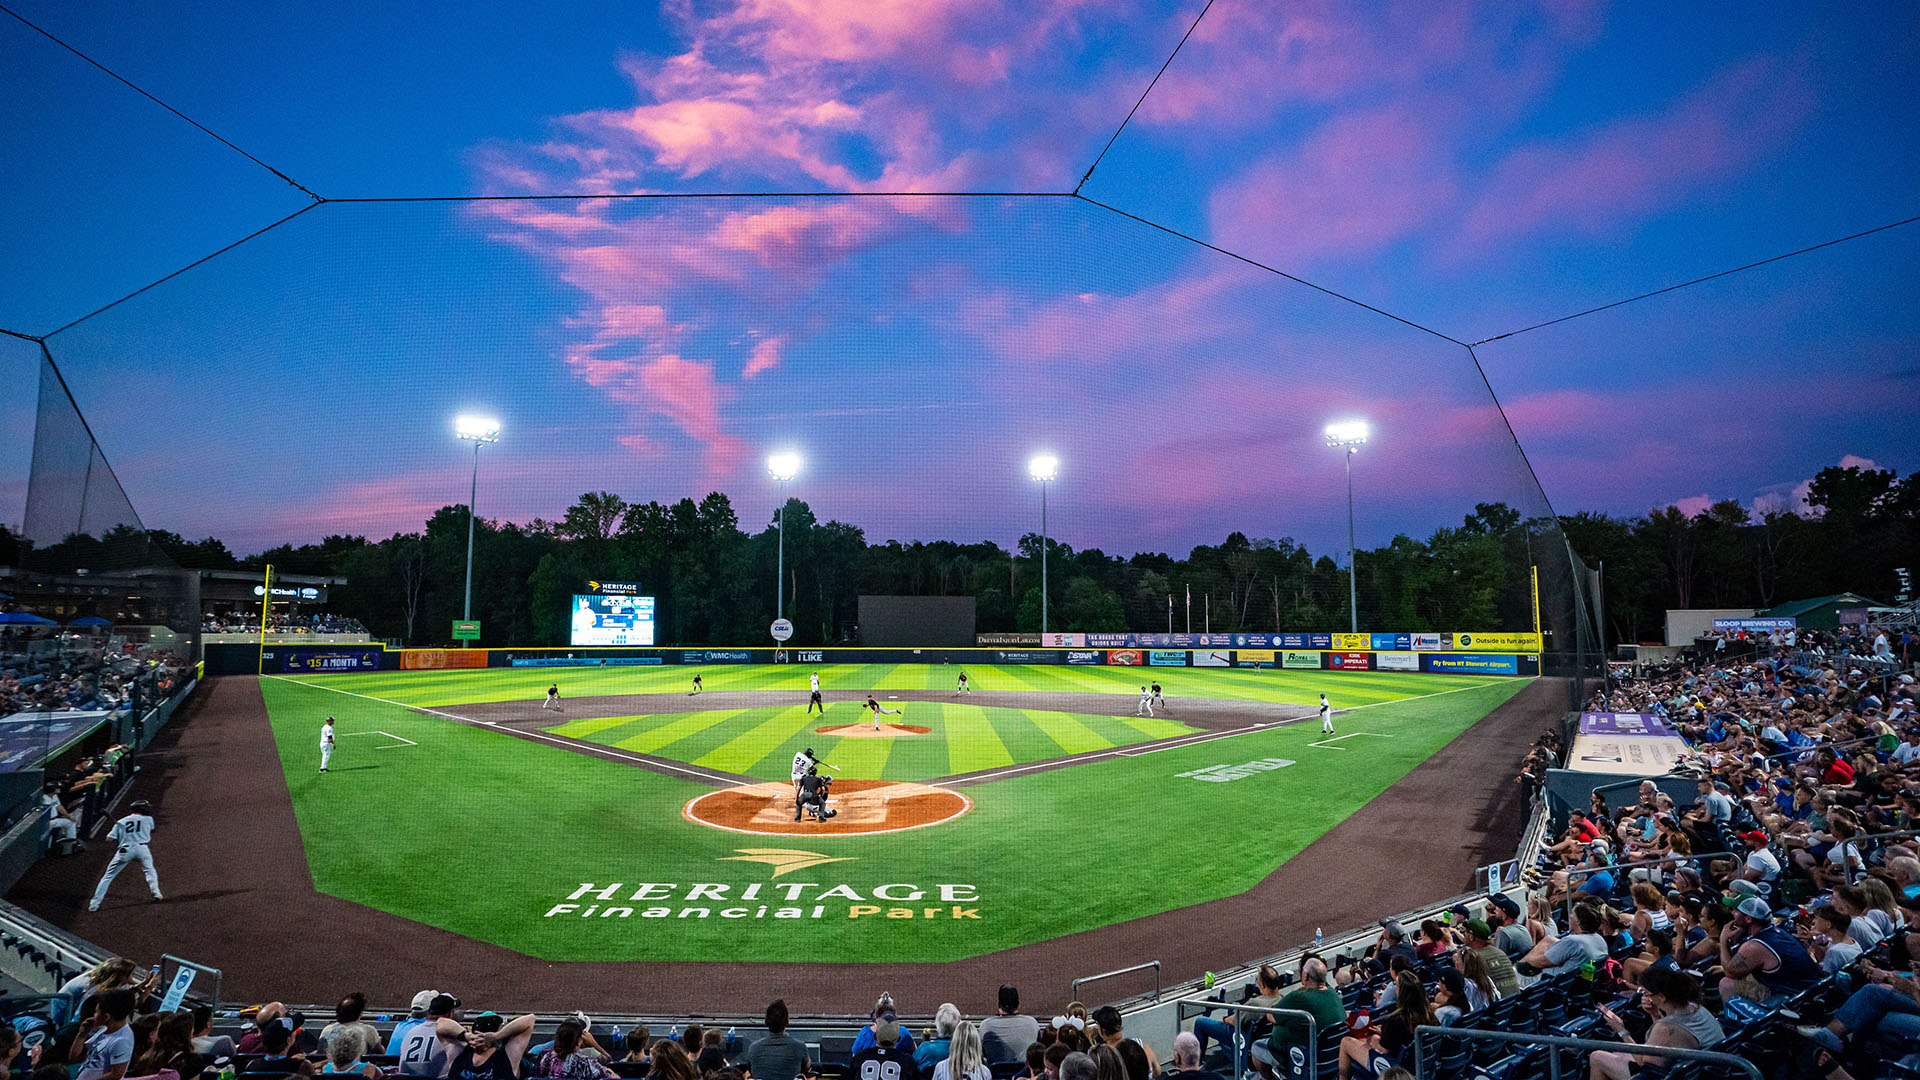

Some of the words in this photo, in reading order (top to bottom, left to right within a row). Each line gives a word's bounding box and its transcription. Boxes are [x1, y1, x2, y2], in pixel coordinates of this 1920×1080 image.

[307, 659, 322, 668] $15
[322, 659, 329, 667] A
[330, 658, 358, 667] MONTH
[802, 654, 823, 662] LIKE
[795, 756, 806, 767] 23
[125, 820, 142, 833] 21
[565, 883, 981, 902] HERITAGE
[544, 904, 826, 919] Financial
[848, 905, 982, 919] Park
[406, 1036, 436, 1063] 21
[861, 1060, 901, 1080] 99
